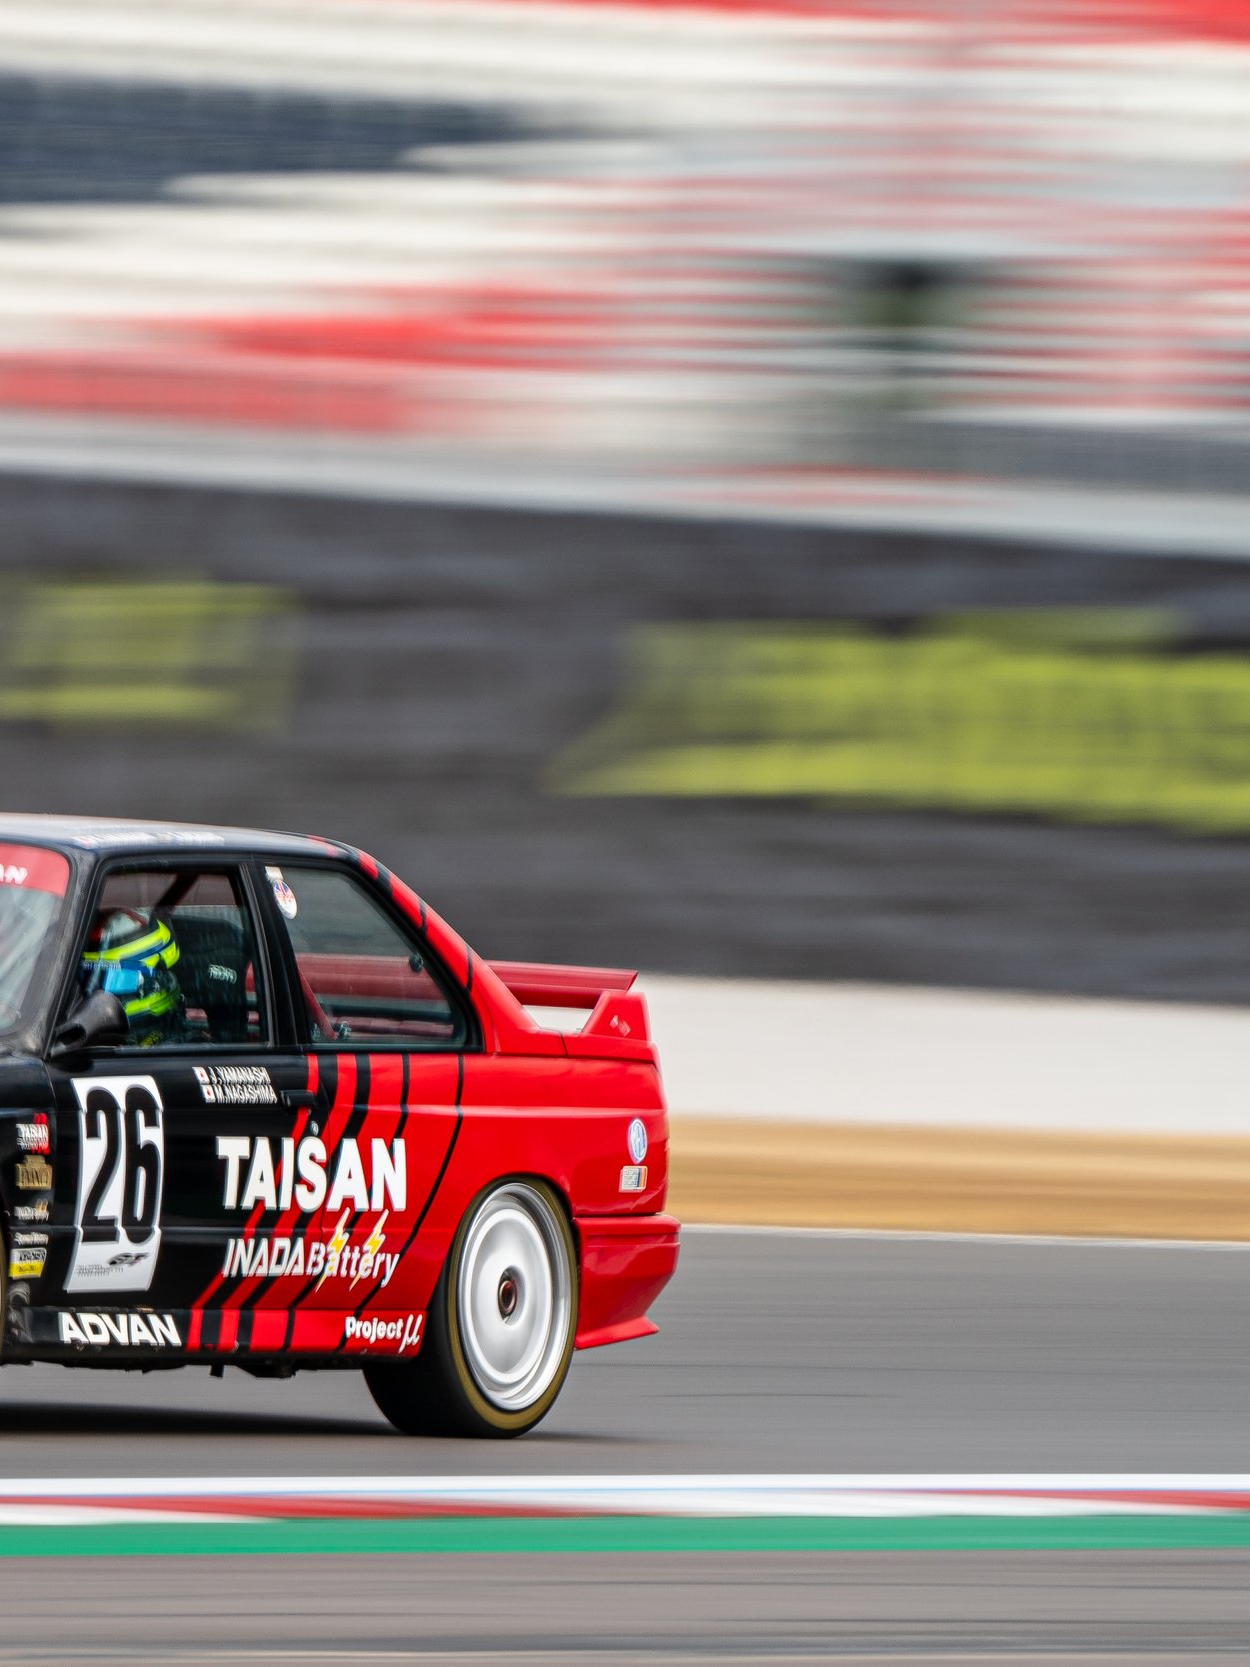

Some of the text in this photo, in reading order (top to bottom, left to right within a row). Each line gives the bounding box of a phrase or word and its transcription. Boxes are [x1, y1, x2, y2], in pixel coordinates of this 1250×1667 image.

[212, 1084, 278, 1104] M.NAGASHIMA
[80, 1085, 163, 1245] 26
[215, 1136, 407, 1212] TAISAN
[221, 1238, 400, 1287] INADA Battery
[58, 1311, 183, 1346] ADVAN
[345, 1316, 405, 1343] Project
